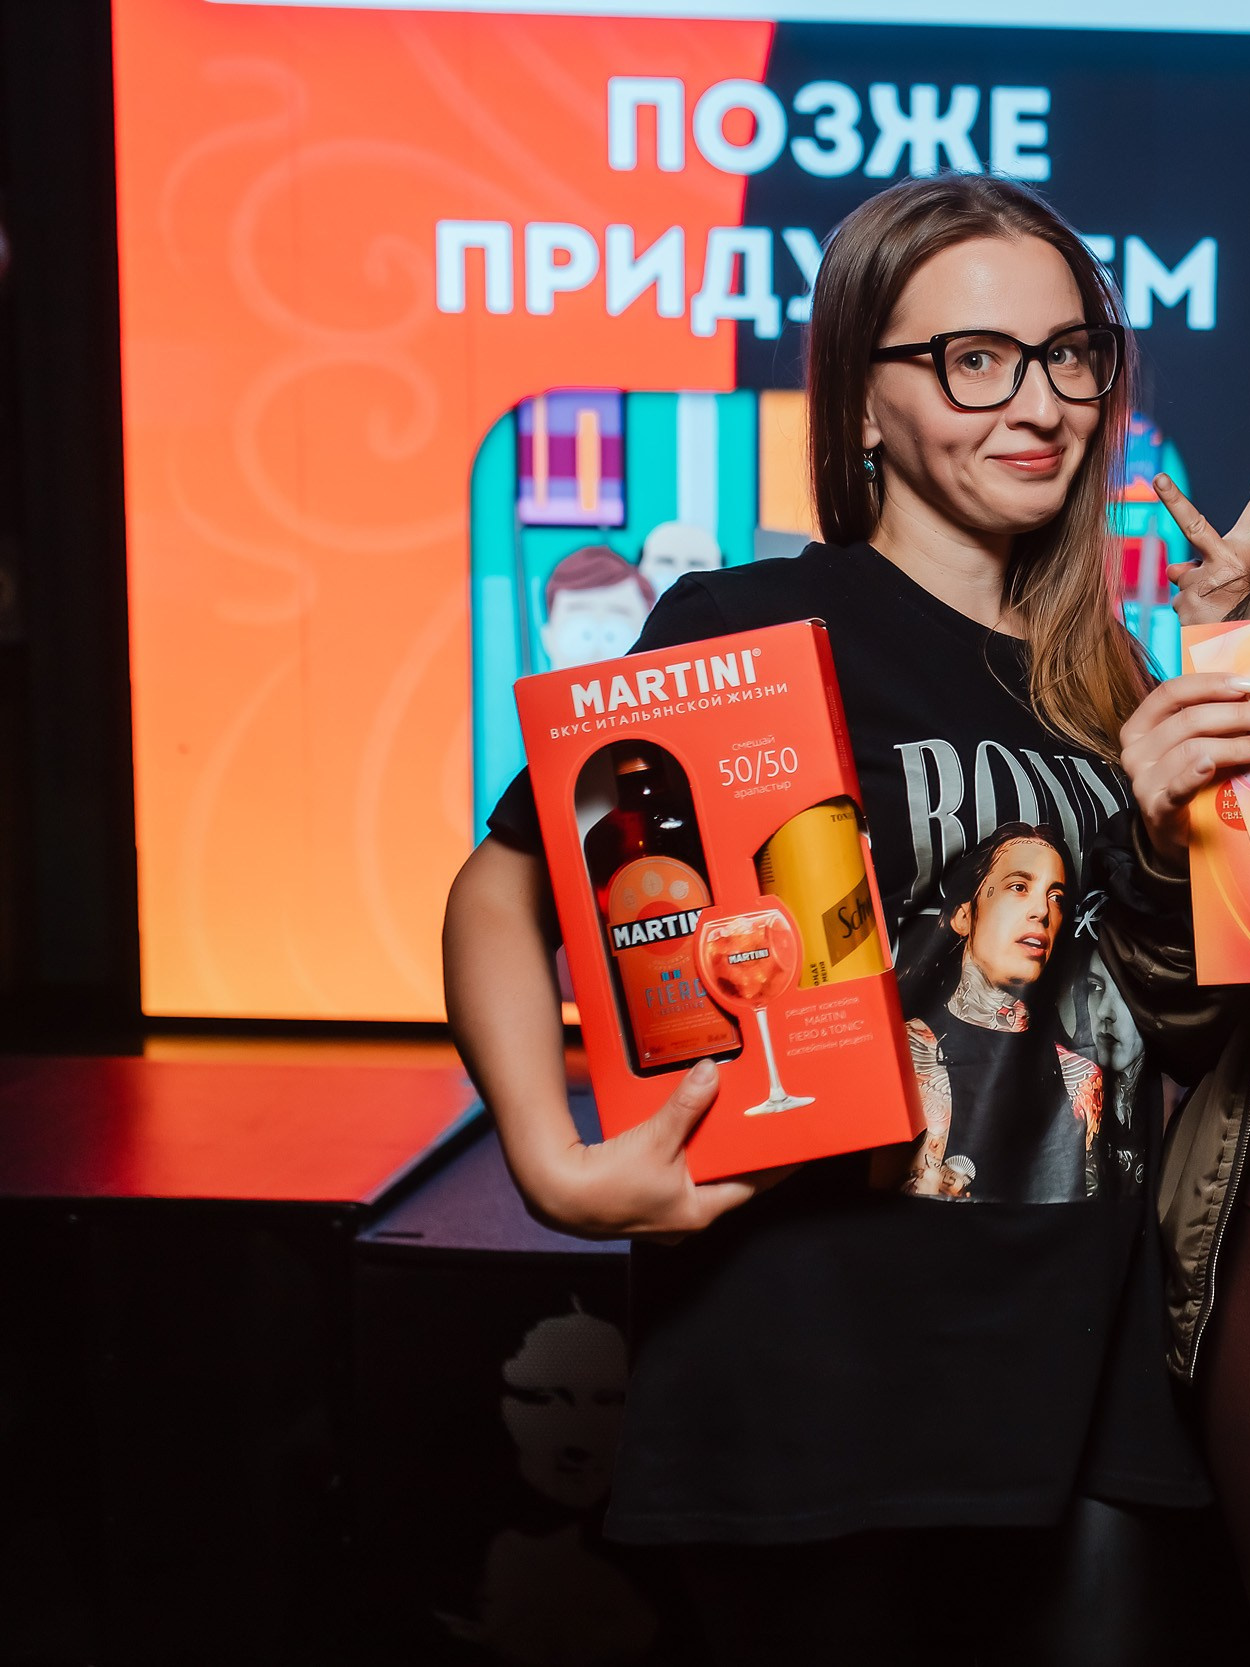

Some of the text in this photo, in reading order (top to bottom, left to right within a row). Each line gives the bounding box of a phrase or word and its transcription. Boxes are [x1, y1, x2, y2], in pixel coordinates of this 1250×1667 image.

[607, 75, 1051, 181] ПОЗЖЕ
[550, 682, 788, 740] ВКУС ИТАЛЬЯНСКОЙ ЖИЗНИ
[731, 734, 776, 752] смешай
[718, 746, 799, 787] 50/50
[613, 909, 703, 948] MARTIN
[728, 948, 769, 964] MARTINI
